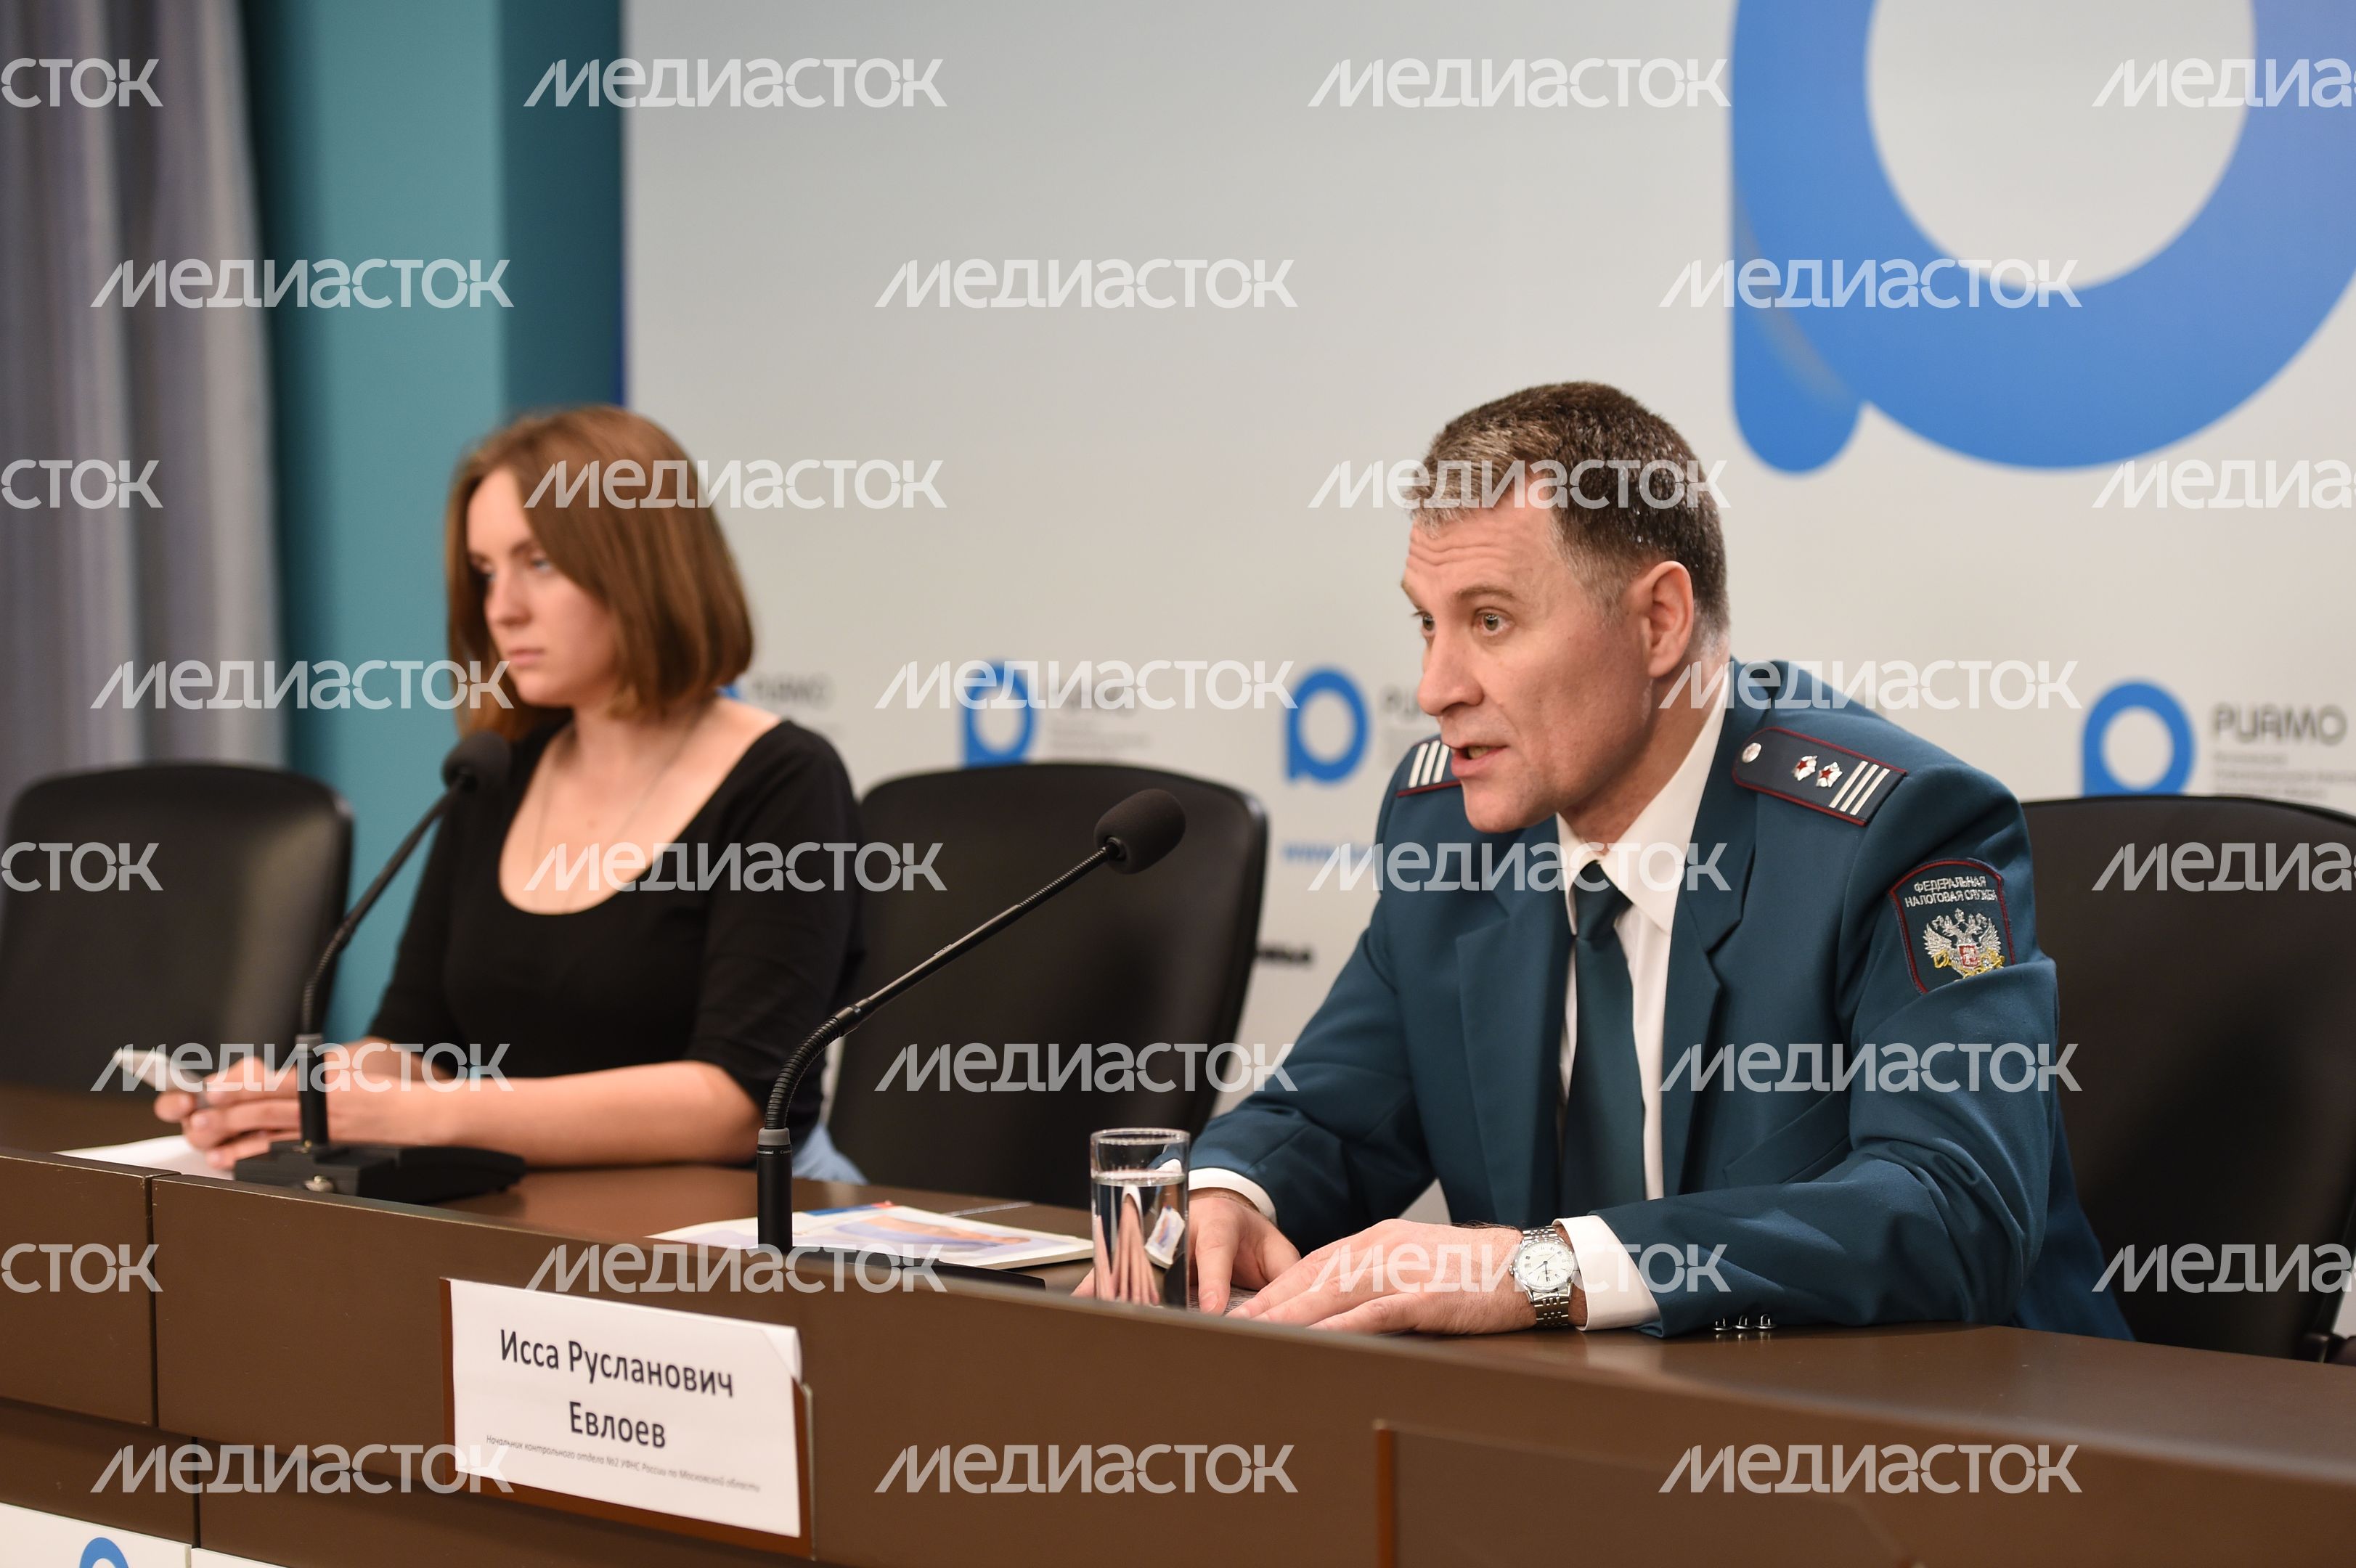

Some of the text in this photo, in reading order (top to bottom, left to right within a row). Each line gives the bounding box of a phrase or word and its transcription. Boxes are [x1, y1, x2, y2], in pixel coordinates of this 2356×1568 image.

[1904, 889, 1964, 907] НАЛОГОВАЯ
[1914, 876, 1986, 894] ФЕДЕРАЛЬНАЯ
[500, 1329, 734, 1398] Исса Русланович
[569, 1401, 667, 1450] Евлоев
[486, 1434, 523, 1449] Начальник
[524, 1444, 575, 1459] контрольного
[576, 1451, 604, 1464] отдела
